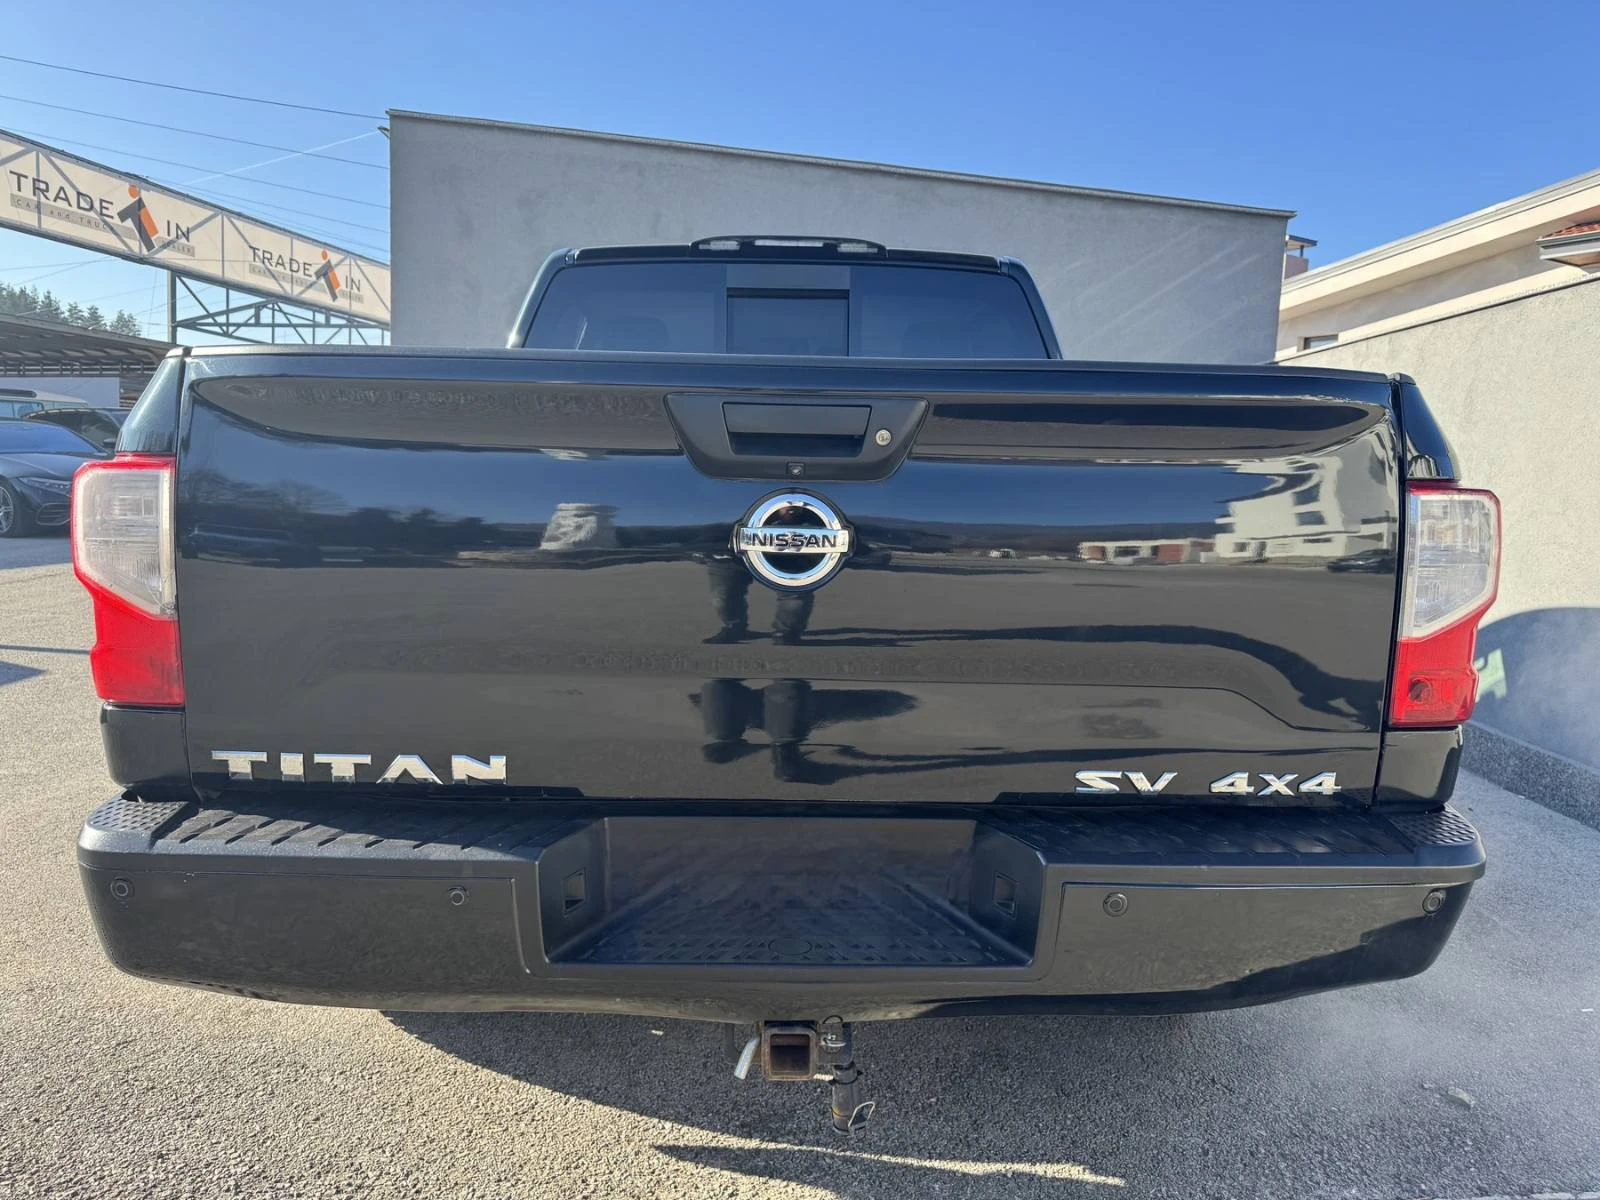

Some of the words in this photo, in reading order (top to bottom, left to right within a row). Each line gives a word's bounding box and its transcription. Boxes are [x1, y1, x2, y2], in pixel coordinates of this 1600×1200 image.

[9, 170, 114, 219] TRADE
[167, 219, 190, 242] IN
[249, 245, 312, 278] TRADE
[345, 275, 361, 292] IN
[751, 532, 837, 548] NISSAN
[211, 750, 507, 785] TITAN
[1074, 770, 1179, 796] SV
